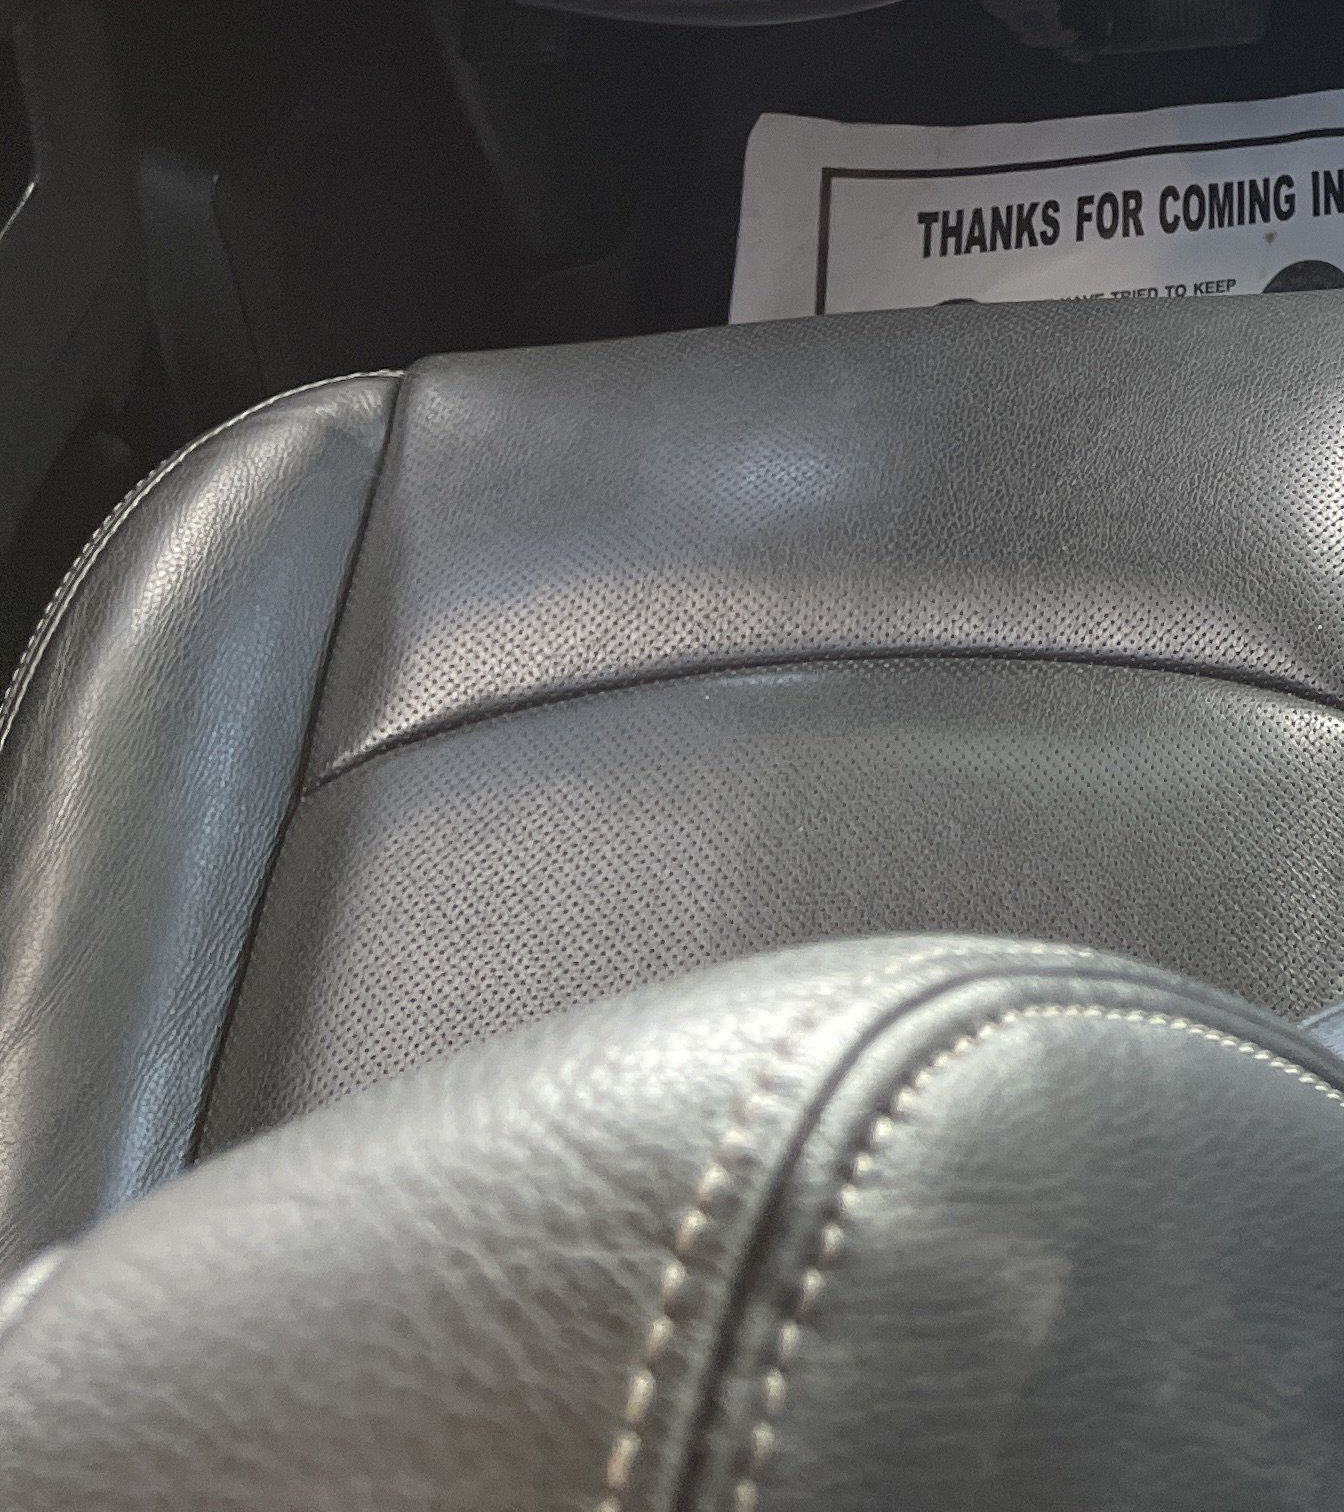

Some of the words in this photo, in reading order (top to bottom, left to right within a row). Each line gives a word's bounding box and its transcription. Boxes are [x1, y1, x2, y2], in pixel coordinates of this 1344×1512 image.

[918, 204, 1060, 259] THANKS
[1076, 189, 1144, 241] FOR
[1159, 174, 1296, 234] COMING
[1165, 284, 1187, 298] TO
[1193, 279, 1238, 296] KEEP
